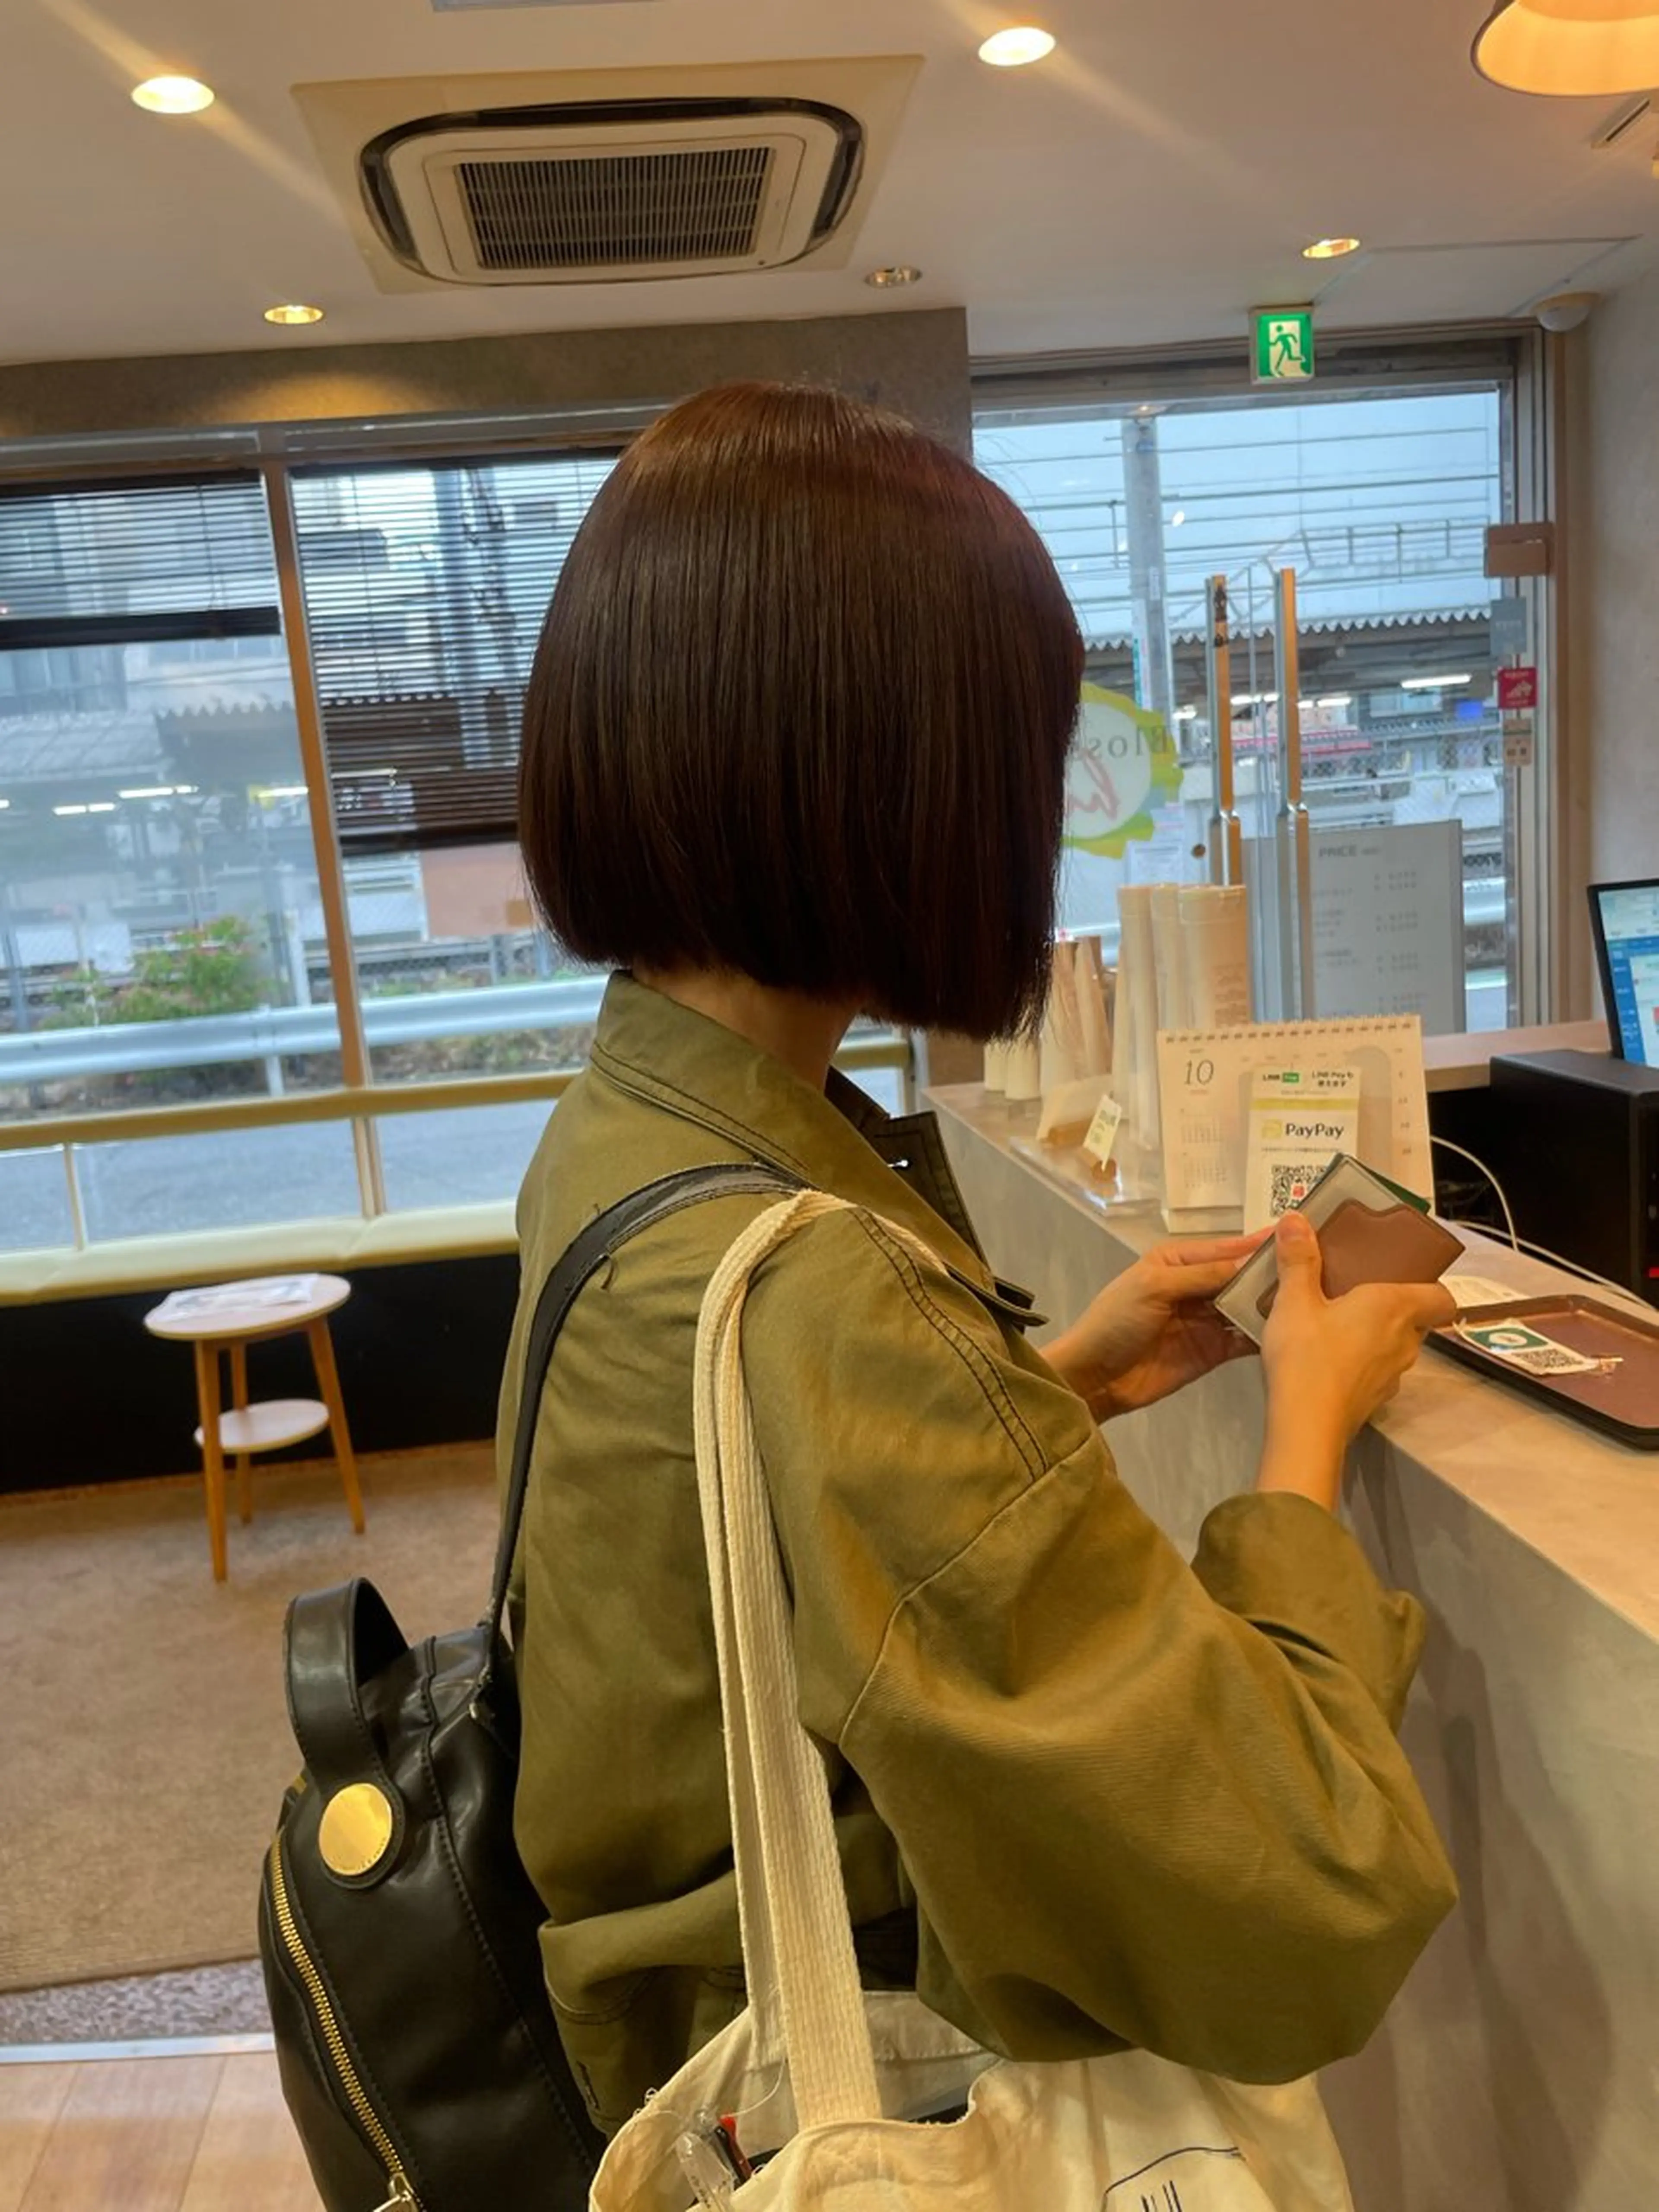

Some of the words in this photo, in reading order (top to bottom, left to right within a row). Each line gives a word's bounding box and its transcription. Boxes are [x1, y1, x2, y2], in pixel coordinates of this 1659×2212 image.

[1319, 844, 1357, 858] PRICE
[1184, 1058, 1214, 1086] 10
[1285, 1122, 1344, 1140] PayPay
